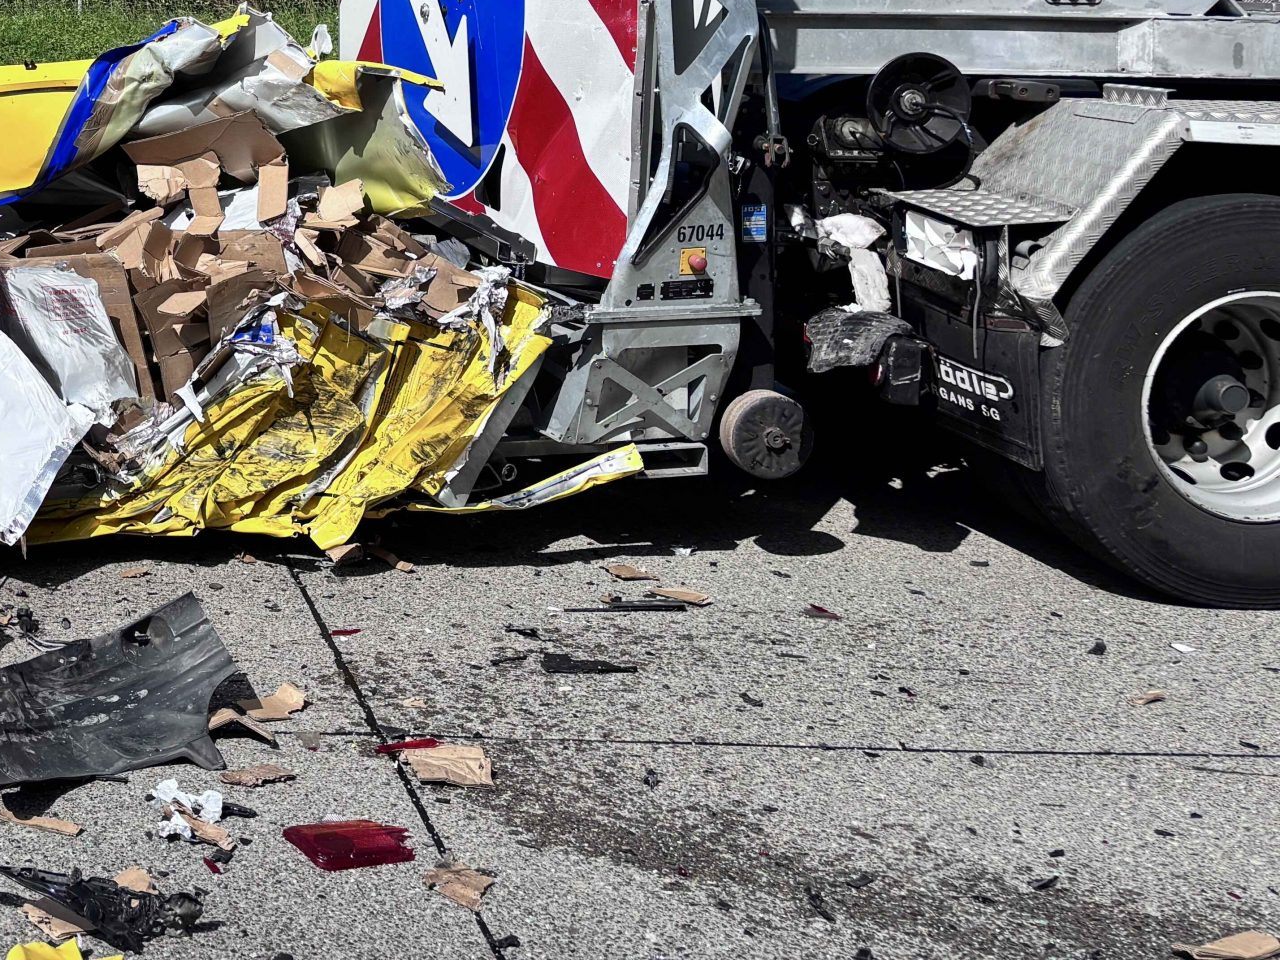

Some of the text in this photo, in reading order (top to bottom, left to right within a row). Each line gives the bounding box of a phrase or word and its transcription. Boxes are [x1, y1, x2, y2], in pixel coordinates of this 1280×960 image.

[677, 223, 725, 243] 67044
[937, 359, 1000, 402] ädle
[928, 382, 1000, 421] RGANS SG
